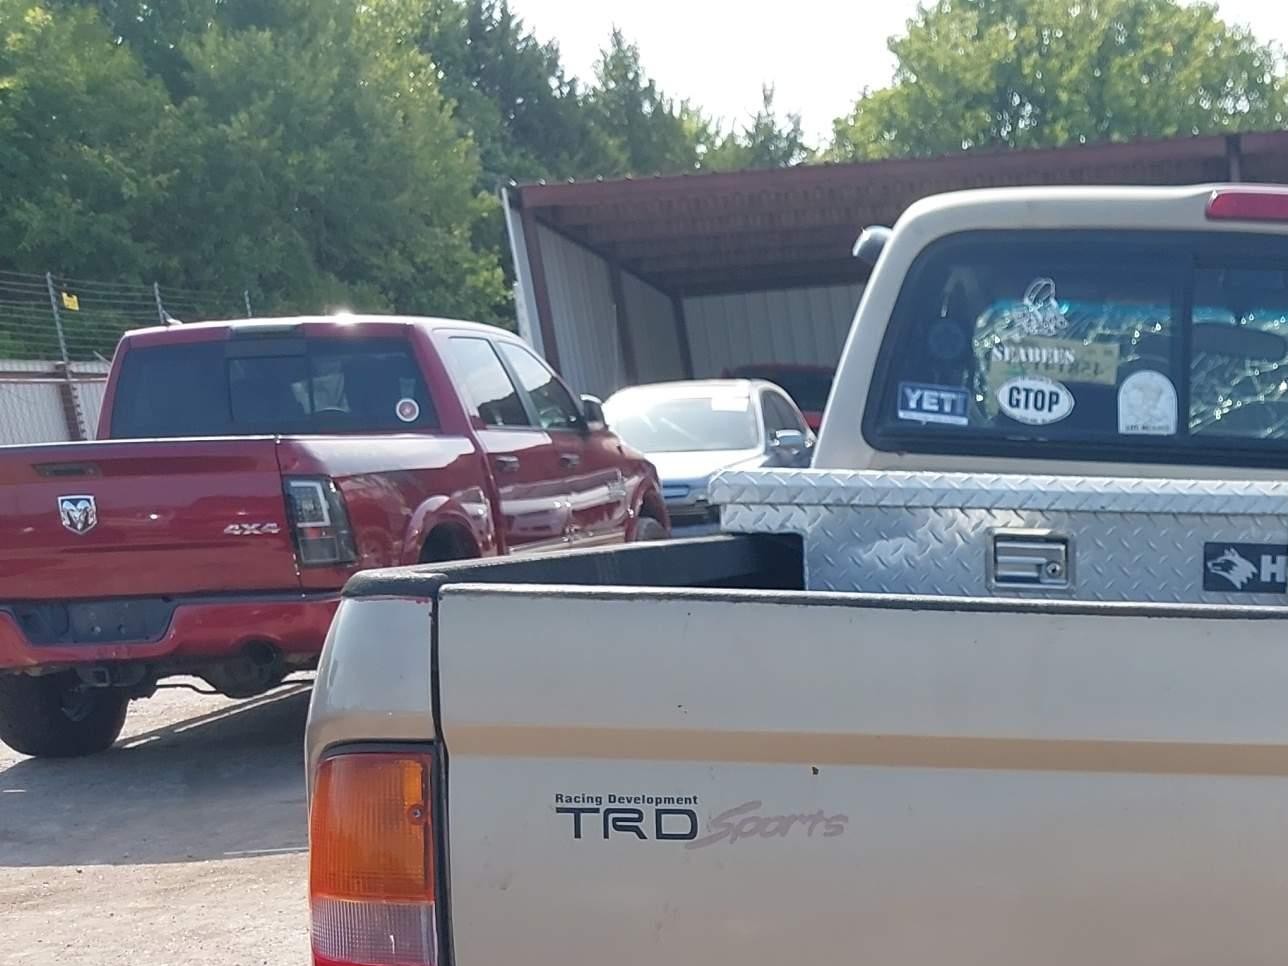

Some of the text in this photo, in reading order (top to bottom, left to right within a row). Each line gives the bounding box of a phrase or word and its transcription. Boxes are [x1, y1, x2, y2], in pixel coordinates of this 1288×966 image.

[903, 387, 965, 413] YETI
[1009, 386, 1060, 412] GTOP
[555, 793, 699, 807] Racing Development
[556, 800, 849, 850] TRD Sports
